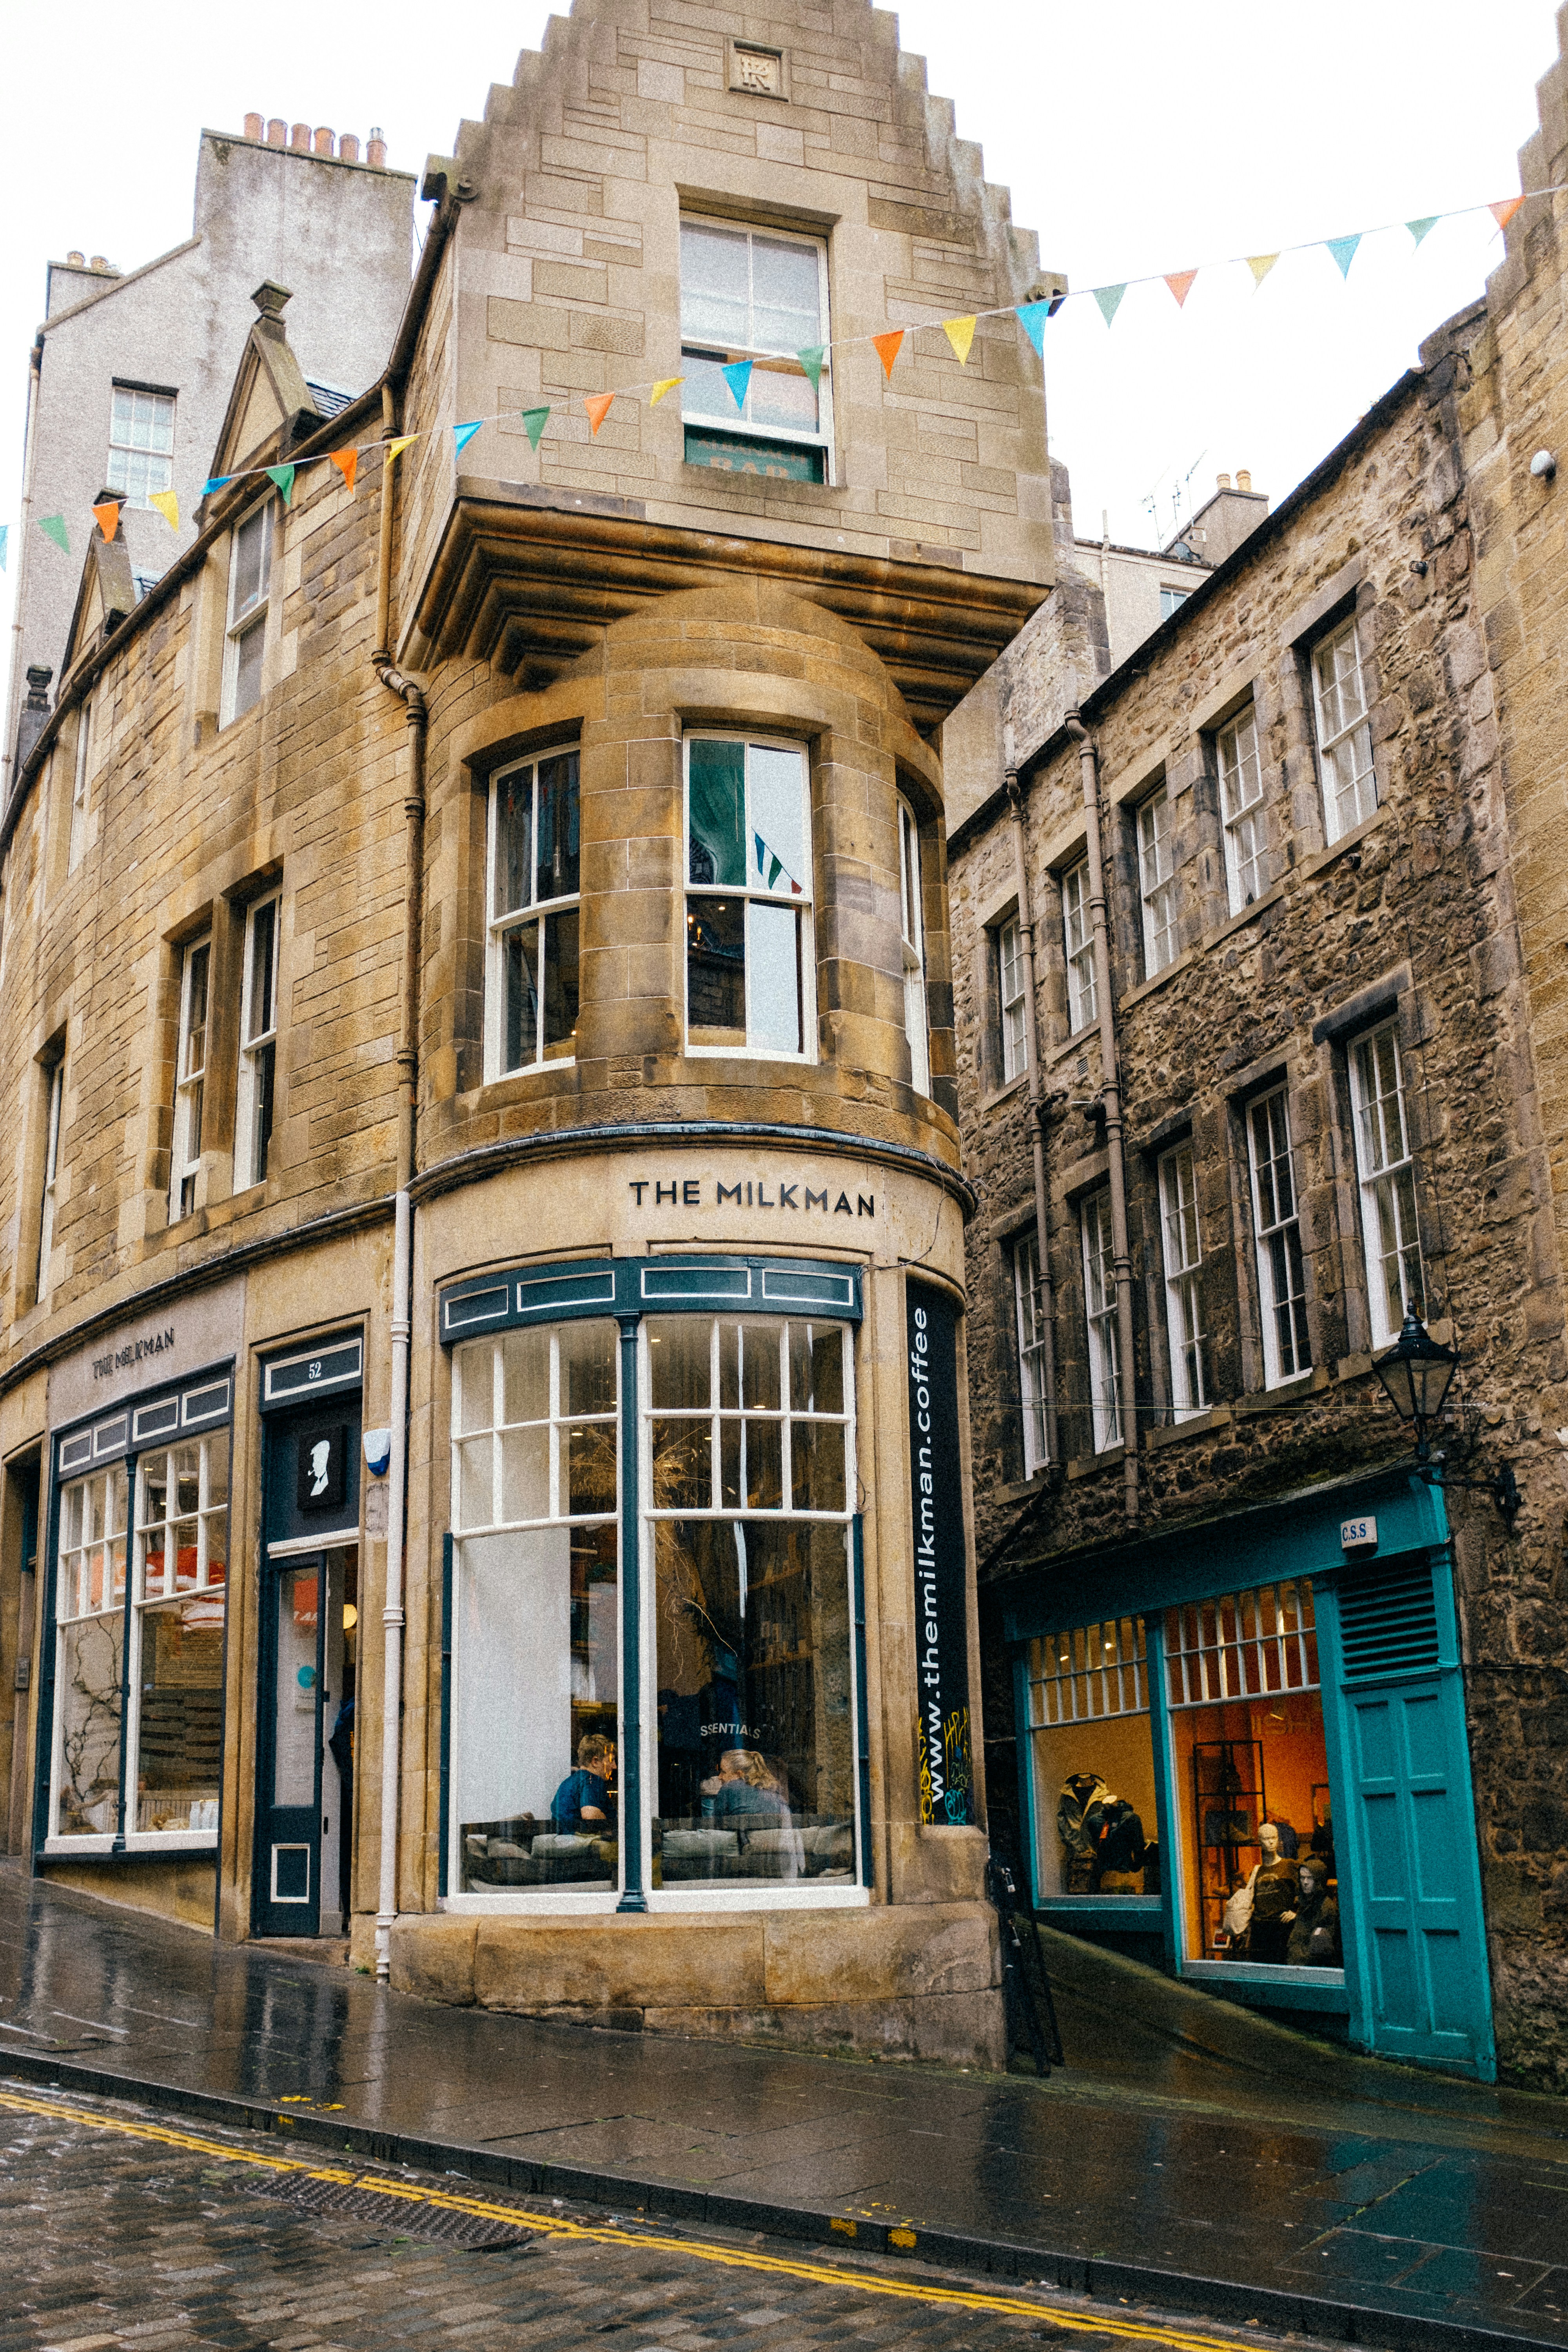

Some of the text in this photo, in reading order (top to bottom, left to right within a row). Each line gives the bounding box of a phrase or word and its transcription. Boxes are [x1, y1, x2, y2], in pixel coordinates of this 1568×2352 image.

[629, 1180, 875, 1218] THE MILKMAN
[92, 1327, 174, 1379] THE MILKMAN
[309, 1361, 321, 1379] 52
[1342, 1523, 1367, 1541] C.S.S
[911, 1307, 944, 1803] www.themilkman.coffee
